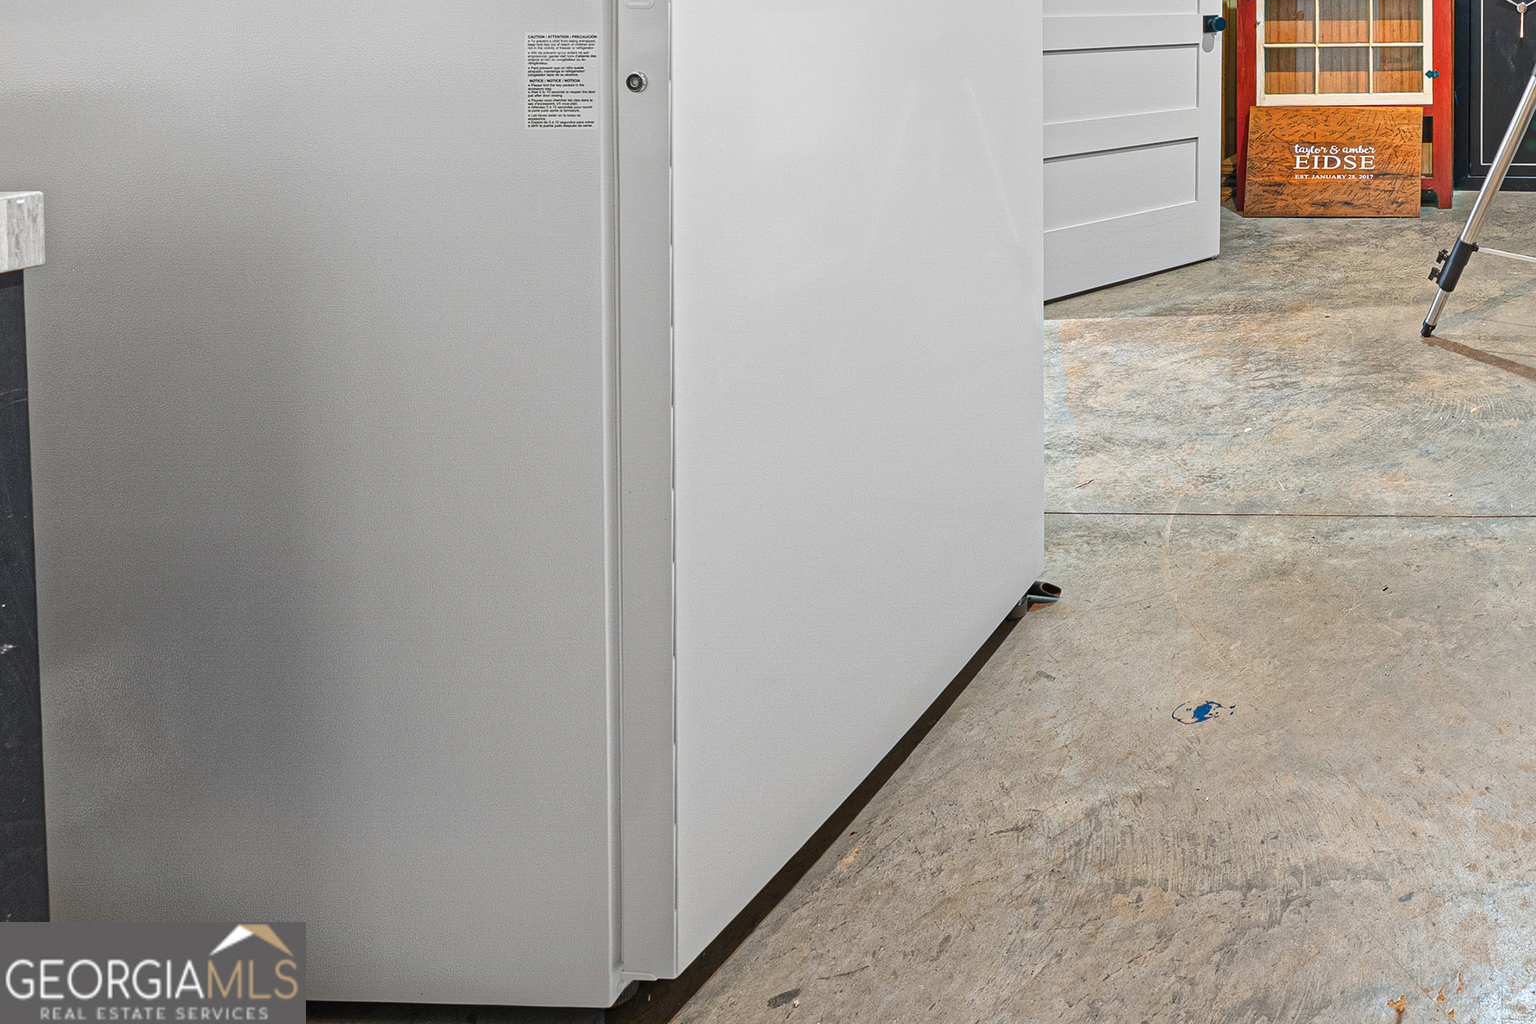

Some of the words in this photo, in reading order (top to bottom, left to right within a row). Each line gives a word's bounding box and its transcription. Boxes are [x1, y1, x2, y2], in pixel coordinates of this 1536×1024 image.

[1294, 144, 1328, 159] taylor
[1329, 145, 1340, 154] &
[1342, 145, 1376, 154] amber
[1293, 155, 1375, 170] EIDSE
